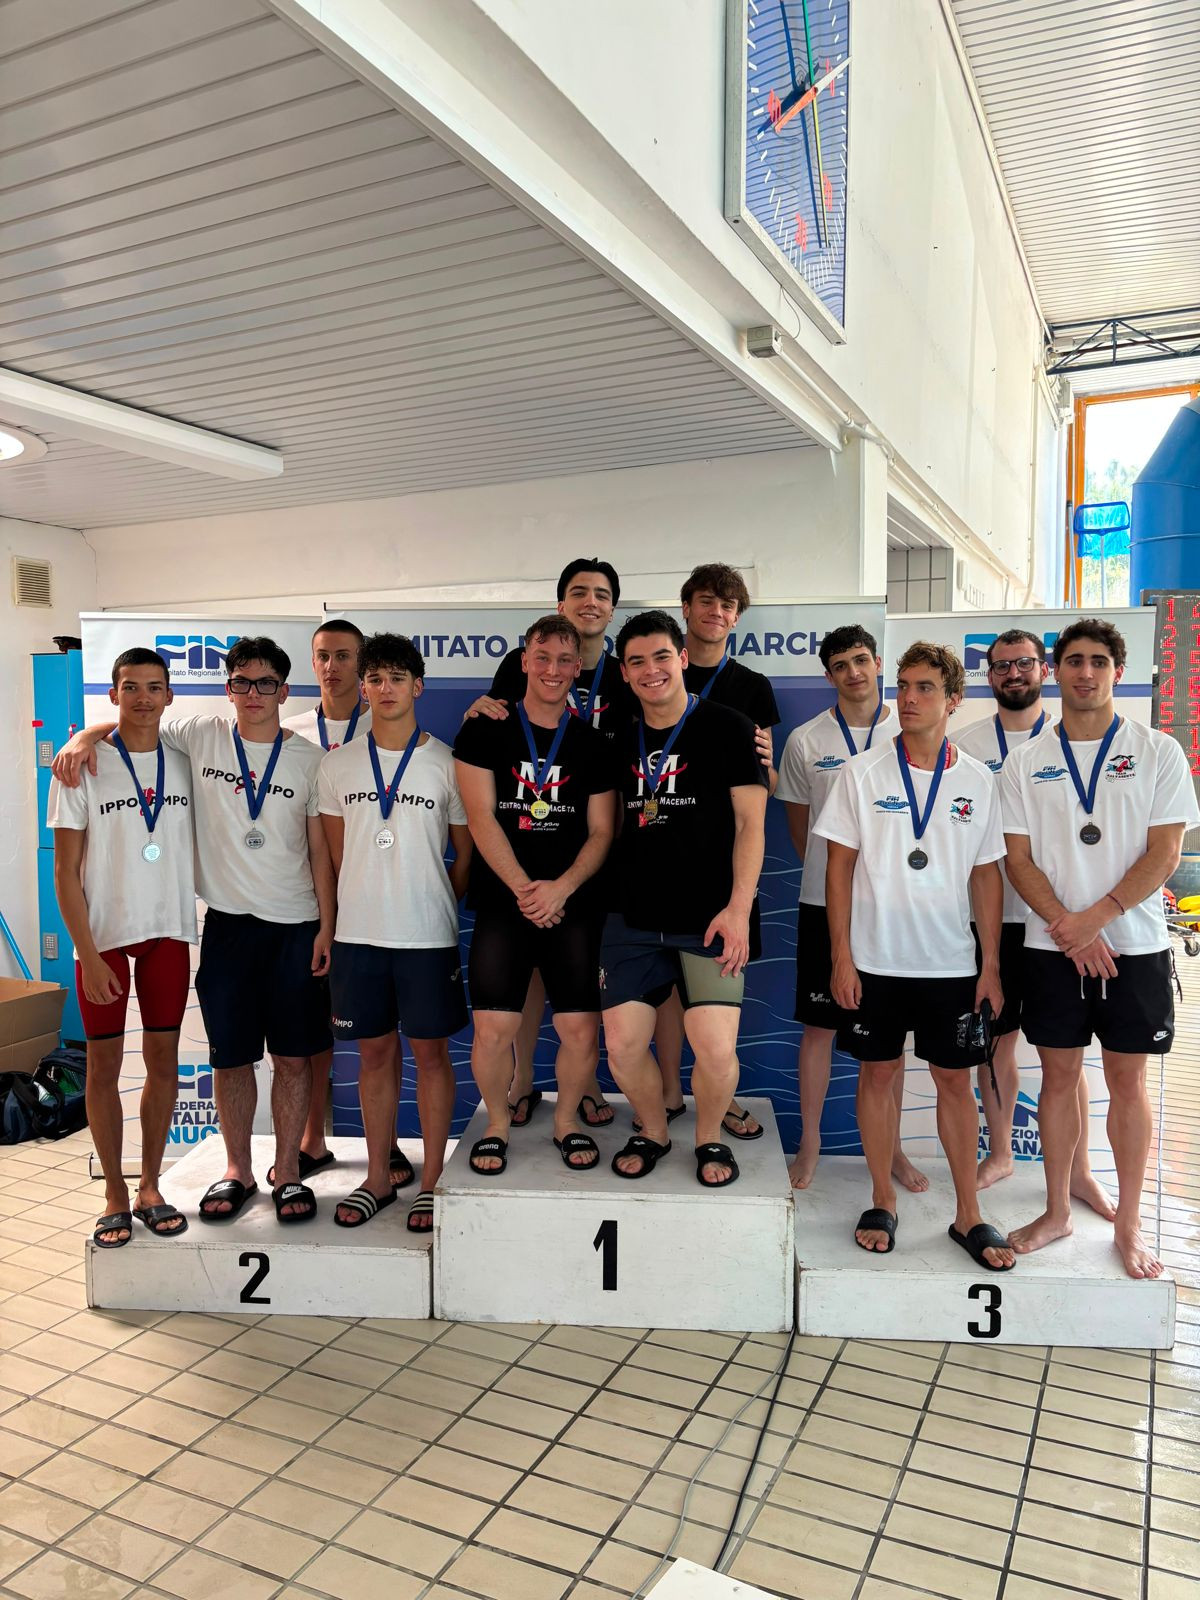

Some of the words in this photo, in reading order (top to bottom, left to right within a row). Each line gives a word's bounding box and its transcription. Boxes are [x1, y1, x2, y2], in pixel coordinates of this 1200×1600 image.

[1166, 599, 1175, 621] 1
[411, 635, 508, 658] ITATO
[1162, 624, 1176, 647] 2
[1162, 650, 1176, 673] 3
[188, 670, 221, 678] Regionale
[1160, 676, 1175, 698] 4
[1160, 701, 1175, 724] 5
[499, 801, 521, 809] CENTRO
[660, 797, 696, 806] MACERATA
[593, 1220, 617, 1291] 1
[239, 1252, 271, 1304] 2
[968, 1284, 1002, 1338] 3
